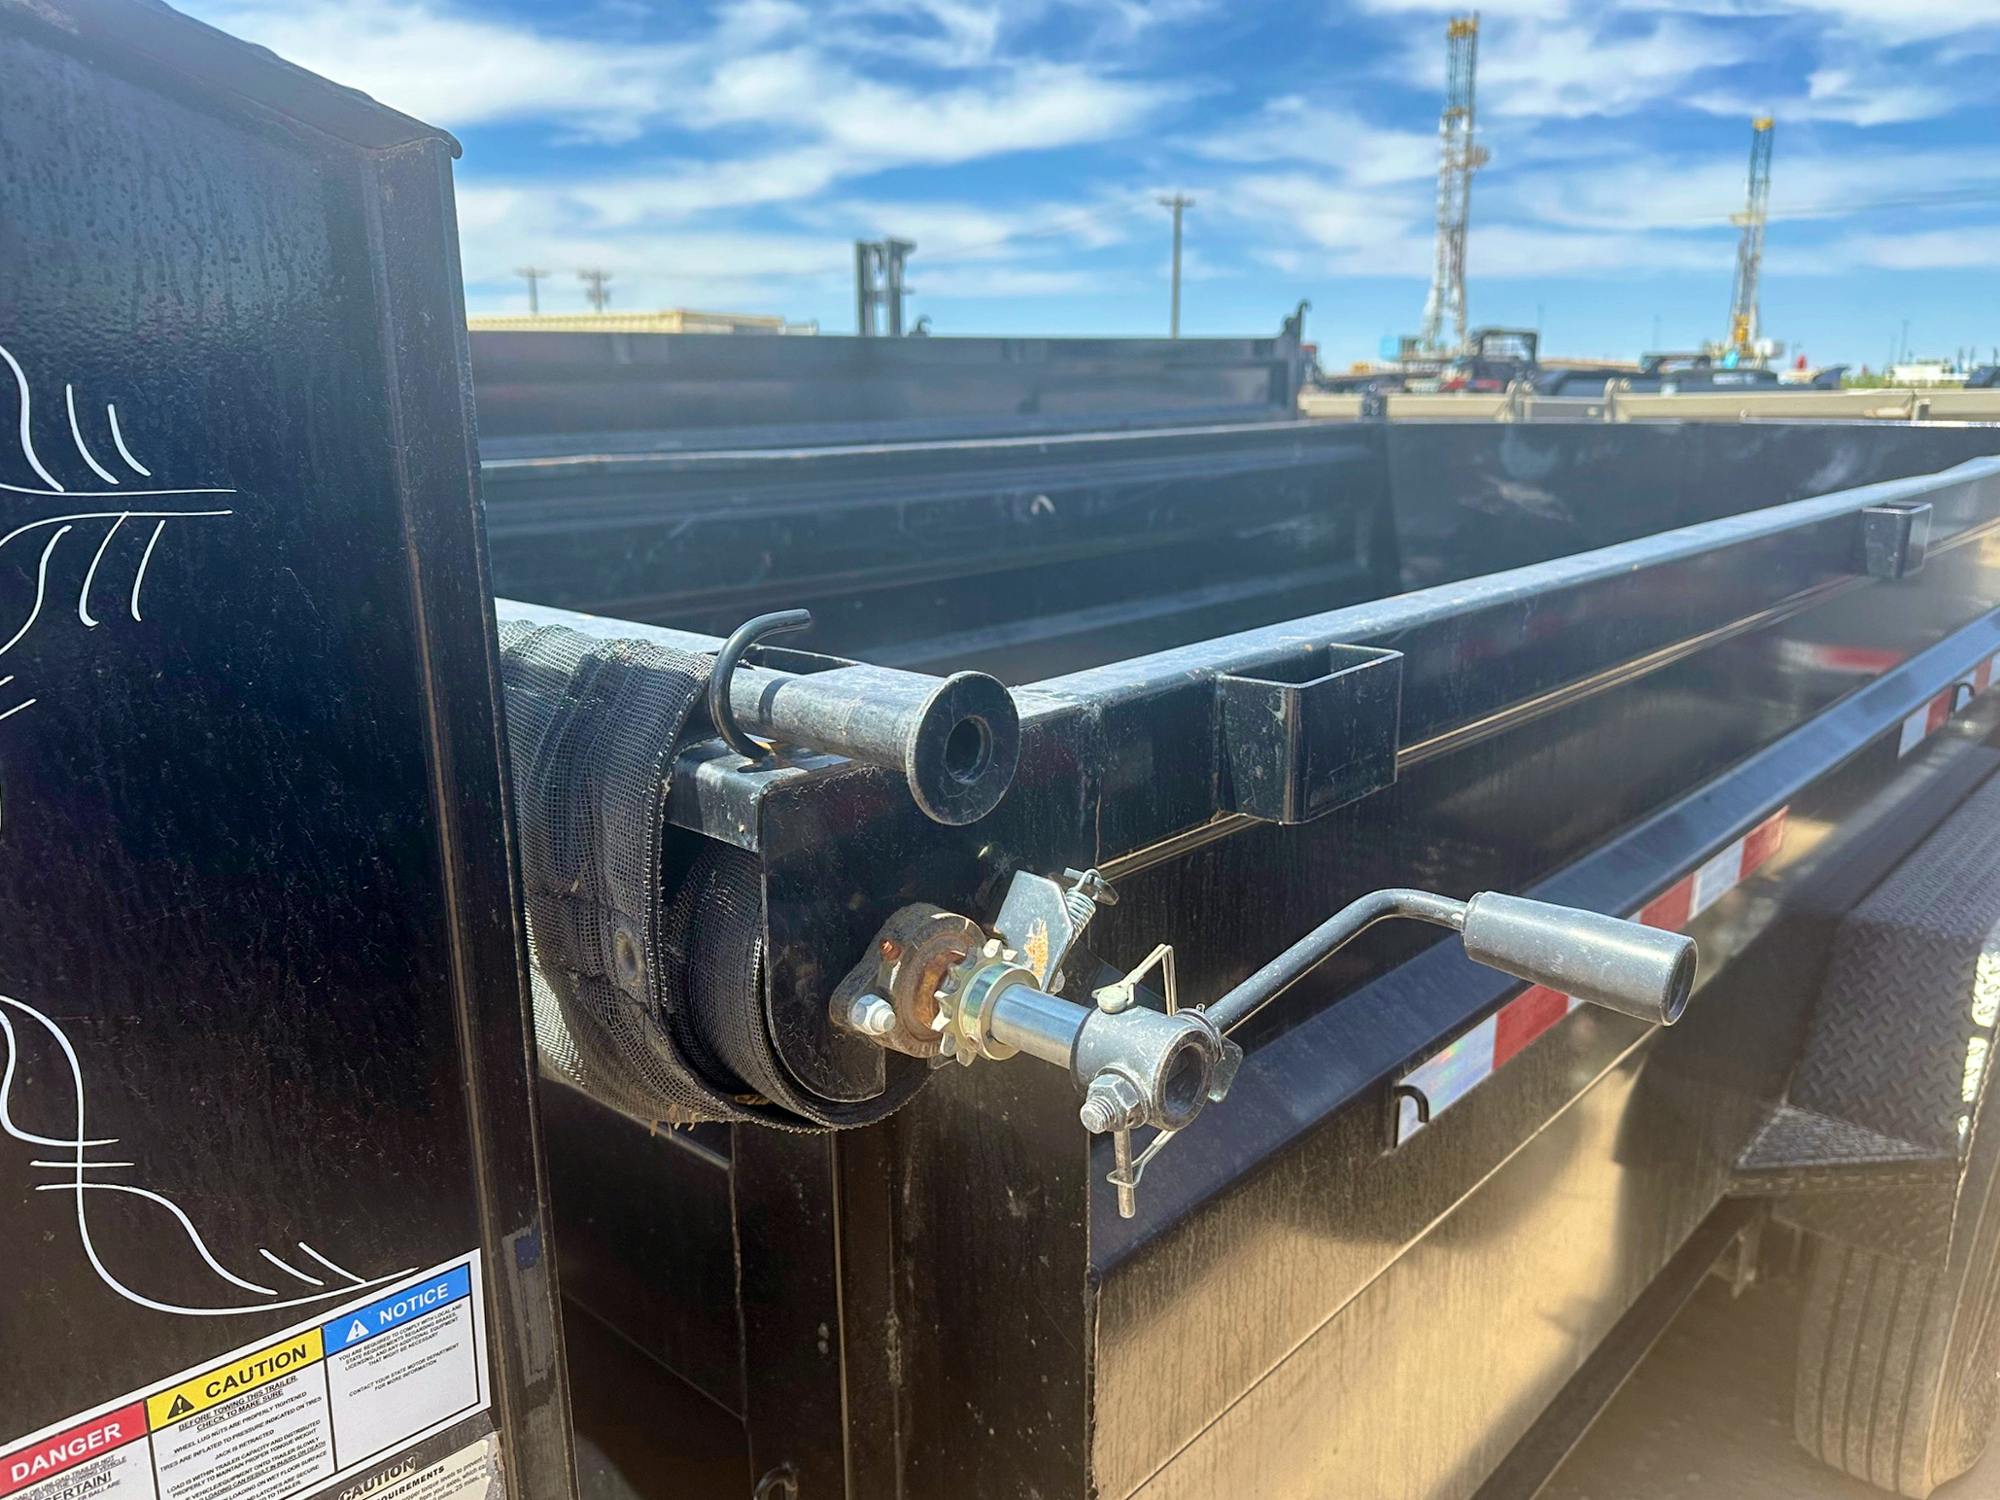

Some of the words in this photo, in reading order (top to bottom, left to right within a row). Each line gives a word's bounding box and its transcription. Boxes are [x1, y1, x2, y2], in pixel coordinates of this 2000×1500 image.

[379, 1282, 449, 1326] NOTICE
[339, 1353, 351, 1362] YOU
[351, 1347, 362, 1357] ARE
[363, 1335, 391, 1351] REQUIRED
[392, 1331, 399, 1339] TO
[400, 1322, 420, 1335] COMPLY
[421, 1315, 434, 1326] WITH
[435, 1308, 451, 1319] LOCAL
[452, 1303, 462, 1312] AND
[346, 1354, 362, 1365] STATE
[363, 1335, 404, 1358] REQUIREMENTS
[405, 1321, 434, 1339] REGARDING
[369, 1357, 382, 1367] THAT
[383, 1349, 399, 1360] MIGHT
[400, 1345, 407, 1353] BE
[408, 1331, 438, 1349] NECESSARY
[376, 1349, 387, 1358] AND
[388, 1343, 398, 1352] ANY
[399, 1329, 429, 1347] ADDITIONAL
[430, 1316, 458, 1333] EQUIPMENT
[205, 1343, 307, 1401] CAUTION
[349, 1382, 374, 1398] CONTACT
[375, 1374, 390, 1385] YOUR
[391, 1367, 406, 1378] STATE
[407, 1358, 426, 1370] MOTOR
[427, 1342, 459, 1361] DEPARTMENT
[375, 1382, 385, 1391] FOR
[387, 1375, 402, 1386] MORE
[403, 1358, 437, 1378] INFORMATION
[174, 1440, 196, 1454] WHEEL
[197, 1433, 211, 1444] LUG
[211, 1426, 228, 1438] NUTS
[228, 1420, 241, 1430] ARE
[242, 1405, 274, 1424] PROPERLY
[275, 1391, 307, 1410] TIGHTENED
[179, 1412, 212, 1432] BEFORE
[214, 1397, 245, 1417] TOWING
[247, 1389, 263, 1402] THIS
[196, 1414, 225, 1432] CHECK
[227, 1409, 237, 1419] TO
[238, 1398, 261, 1414] MAKE
[263, 1388, 283, 1403] SURE
[11, 1423, 122, 1483] DANGER
[160, 1460, 178, 1473] TIRES
[179, 1453, 192, 1464] ARE
[193, 1440, 222, 1458] INFLATED
[223, 1436, 231, 1444] TO
[232, 1421, 264, 1440] PRESSURE
[265, 1408, 294, 1426] INDICATED
[295, 1403, 305, 1412] ON
[306, 1396, 322, 1408] TIRES
[167, 1481, 185, 1494] LOAD
[185, 1478, 192, 1486] IS
[192, 1467, 214, 1482] WITHIN
[215, 1456, 240, 1472] TRAILER
[241, 1442, 270, 1460] CAPACITY
[271, 1436, 283, 1447] AND
[284, 1419, 320, 1441] DISTRIBUTED
[215, 1448, 231, 1460] JACK
[240, 1429, 274, 1449] RETRACTED
[254, 1459, 271, 1471] ONTO
[272, 1448, 295, 1463] TRAILER
[297, 1437, 319, 1452] SLOWLY
[173, 1479, 205, 1499] PROPERLY
[207, 1474, 215, 1483] TO
[216, 1462, 242, 1479] MAINTAIN
[243, 1450, 269, 1466] PROPER
[270, 1438, 294, 1454] TONGUE
[295, 1428, 317, 1443] WEIGHT
[229, 1483, 256, 1500] LOADING
[257, 1478, 266, 1487] ON
[267, 1472, 280, 1483] WET
[280, 1463, 300, 1477] FLOOR
[301, 1450, 327, 1467] SURFACE
[232, 1478, 245, 1488] CAN
[247, 1466, 269, 1481] RESULT
[277, 1454, 296, 1467] INJURY
[297, 1450, 306, 1458] OR
[256, 1481, 282, 1498] LATCHES
[283, 1475, 294, 1486] ARE
[296, 1464, 319, 1480] SECURE
[338, 1457, 416, 1500] CAUTION
[88, 1486, 105, 1498] BALL
[107, 1479, 121, 1490] ARE
[268, 1492, 276, 1500] TO
[277, 1480, 301, 1496] TRAILER
